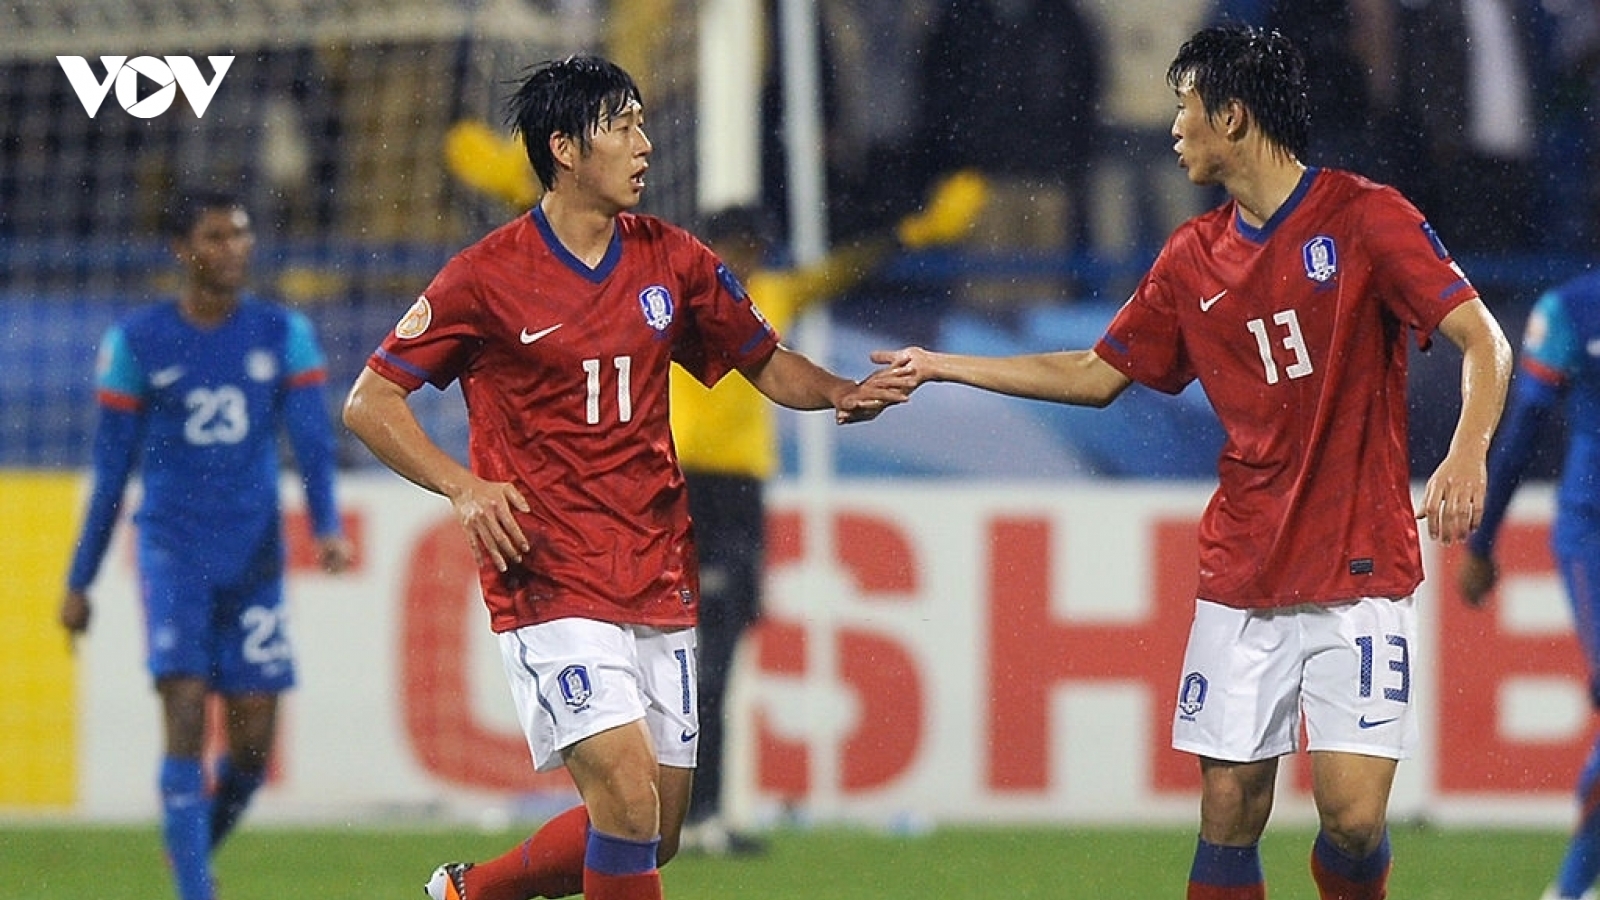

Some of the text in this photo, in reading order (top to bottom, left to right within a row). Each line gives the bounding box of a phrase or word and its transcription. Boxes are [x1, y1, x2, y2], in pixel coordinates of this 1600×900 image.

[1247, 309, 1313, 384] 13
[184, 386, 248, 445] 23
[583, 355, 632, 424] 11
[1355, 633, 1410, 704] 13
